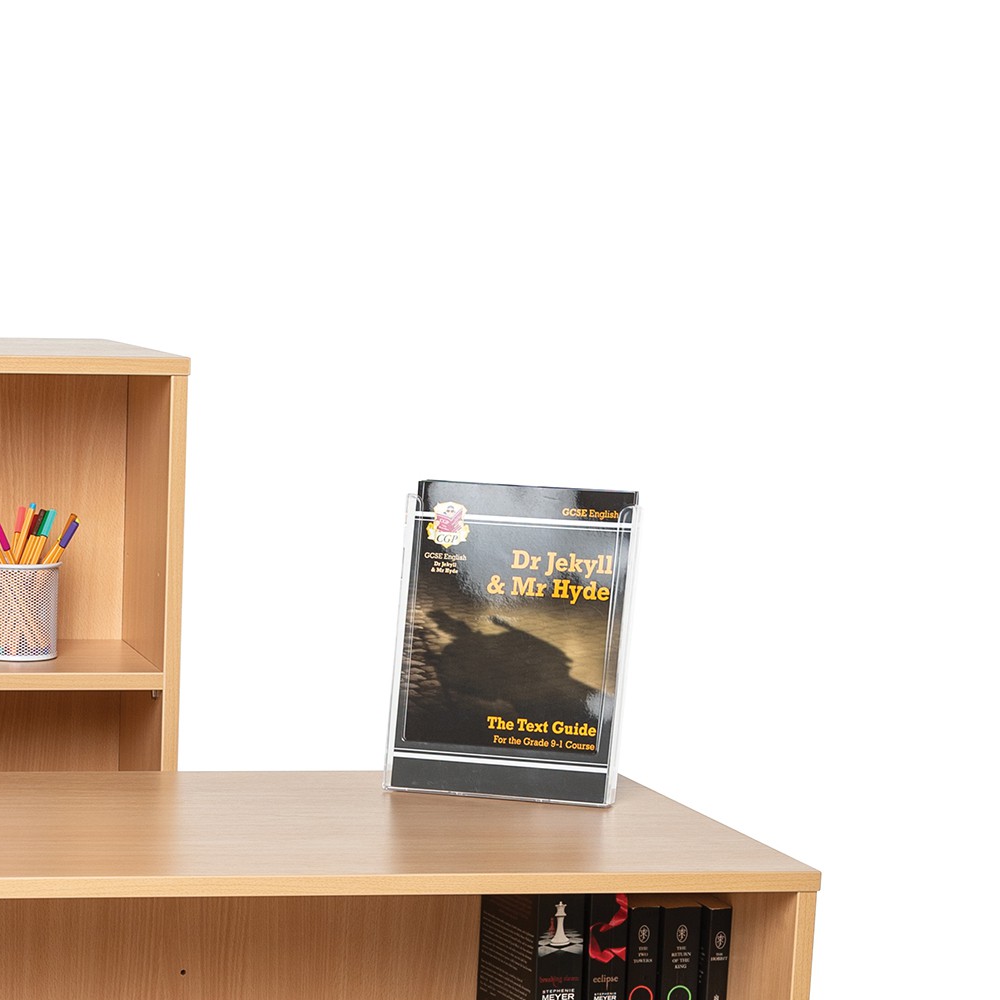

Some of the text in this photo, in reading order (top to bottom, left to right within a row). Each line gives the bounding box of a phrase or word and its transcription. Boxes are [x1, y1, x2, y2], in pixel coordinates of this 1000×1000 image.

[562, 508, 619, 520] GCSE English
[436, 533, 458, 543] CGP
[444, 553, 467, 561] English
[511, 549, 613, 579] Dr Jekyll
[486, 575, 610, 605] & Mr Hyde
[487, 716, 597, 737] The Text Guide
[493, 735, 595, 751] For the Grade 9-1 Course
[592, 974, 619, 990] eclipse
